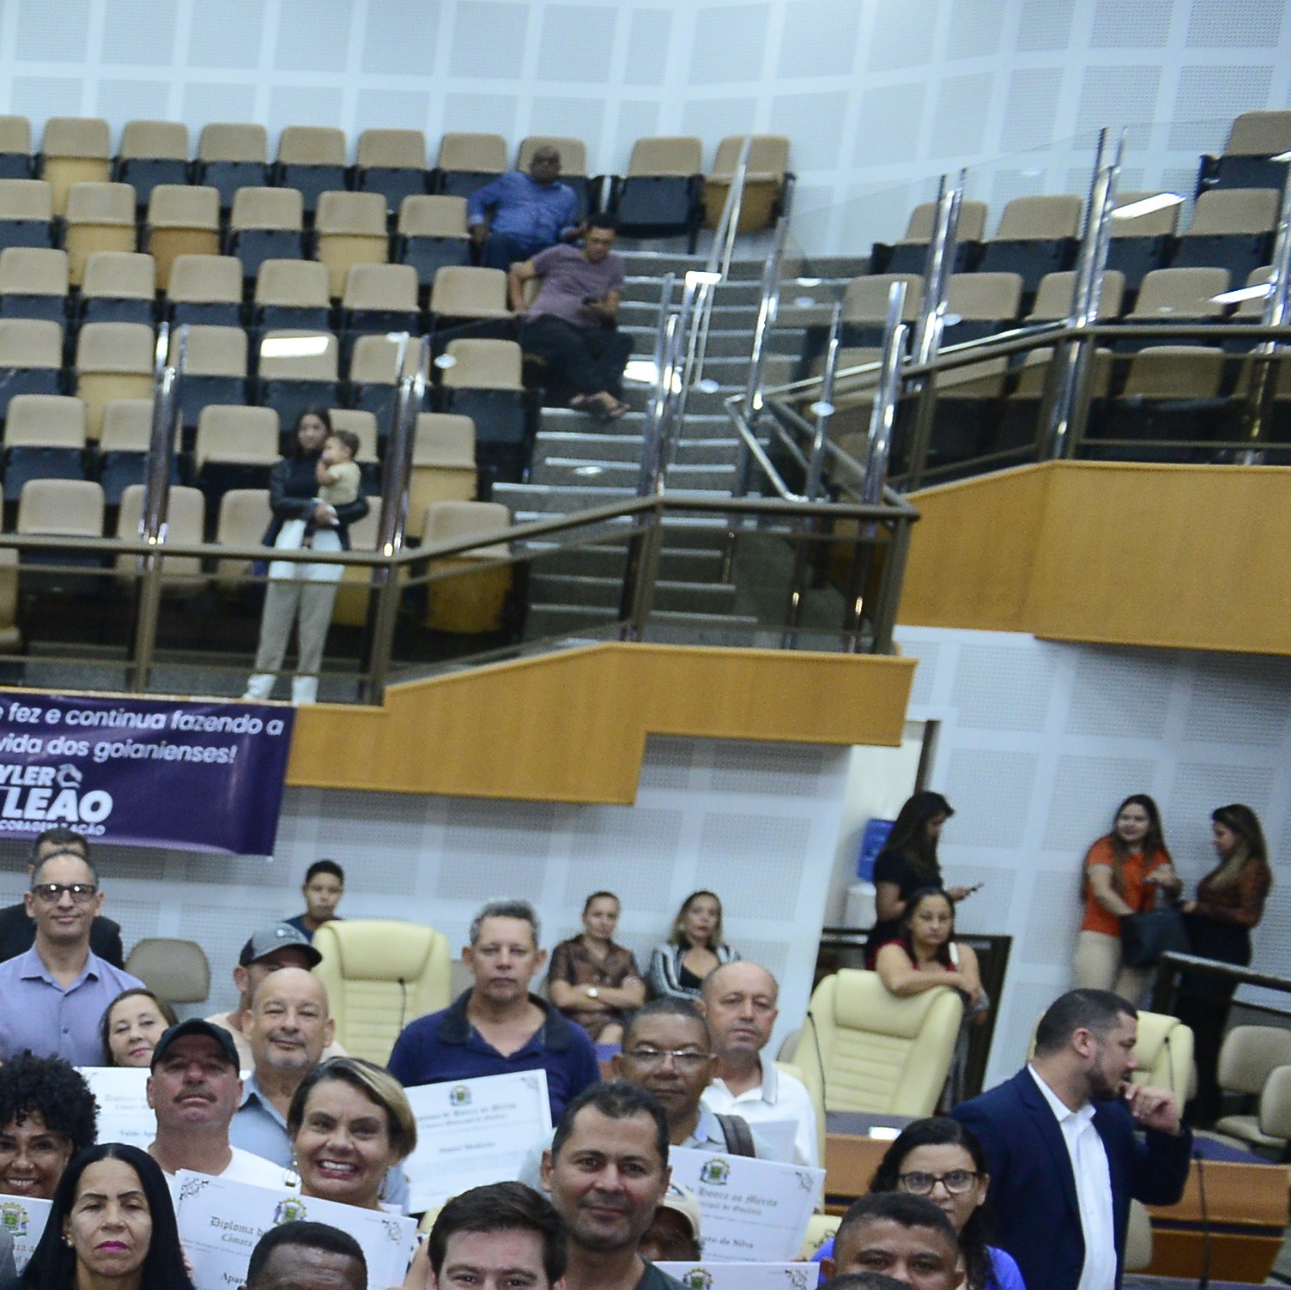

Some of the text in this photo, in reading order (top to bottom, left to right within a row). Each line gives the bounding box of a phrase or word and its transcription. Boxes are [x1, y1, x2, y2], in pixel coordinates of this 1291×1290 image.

[8, 702, 40, 723] fez
[45, 710, 60, 724] e
[66, 705, 164, 730] continua
[170, 708, 261, 735] fazendo
[267, 720, 284, 736] a
[48, 734, 89, 756] dos
[94, 738, 237, 765] goianienses!
